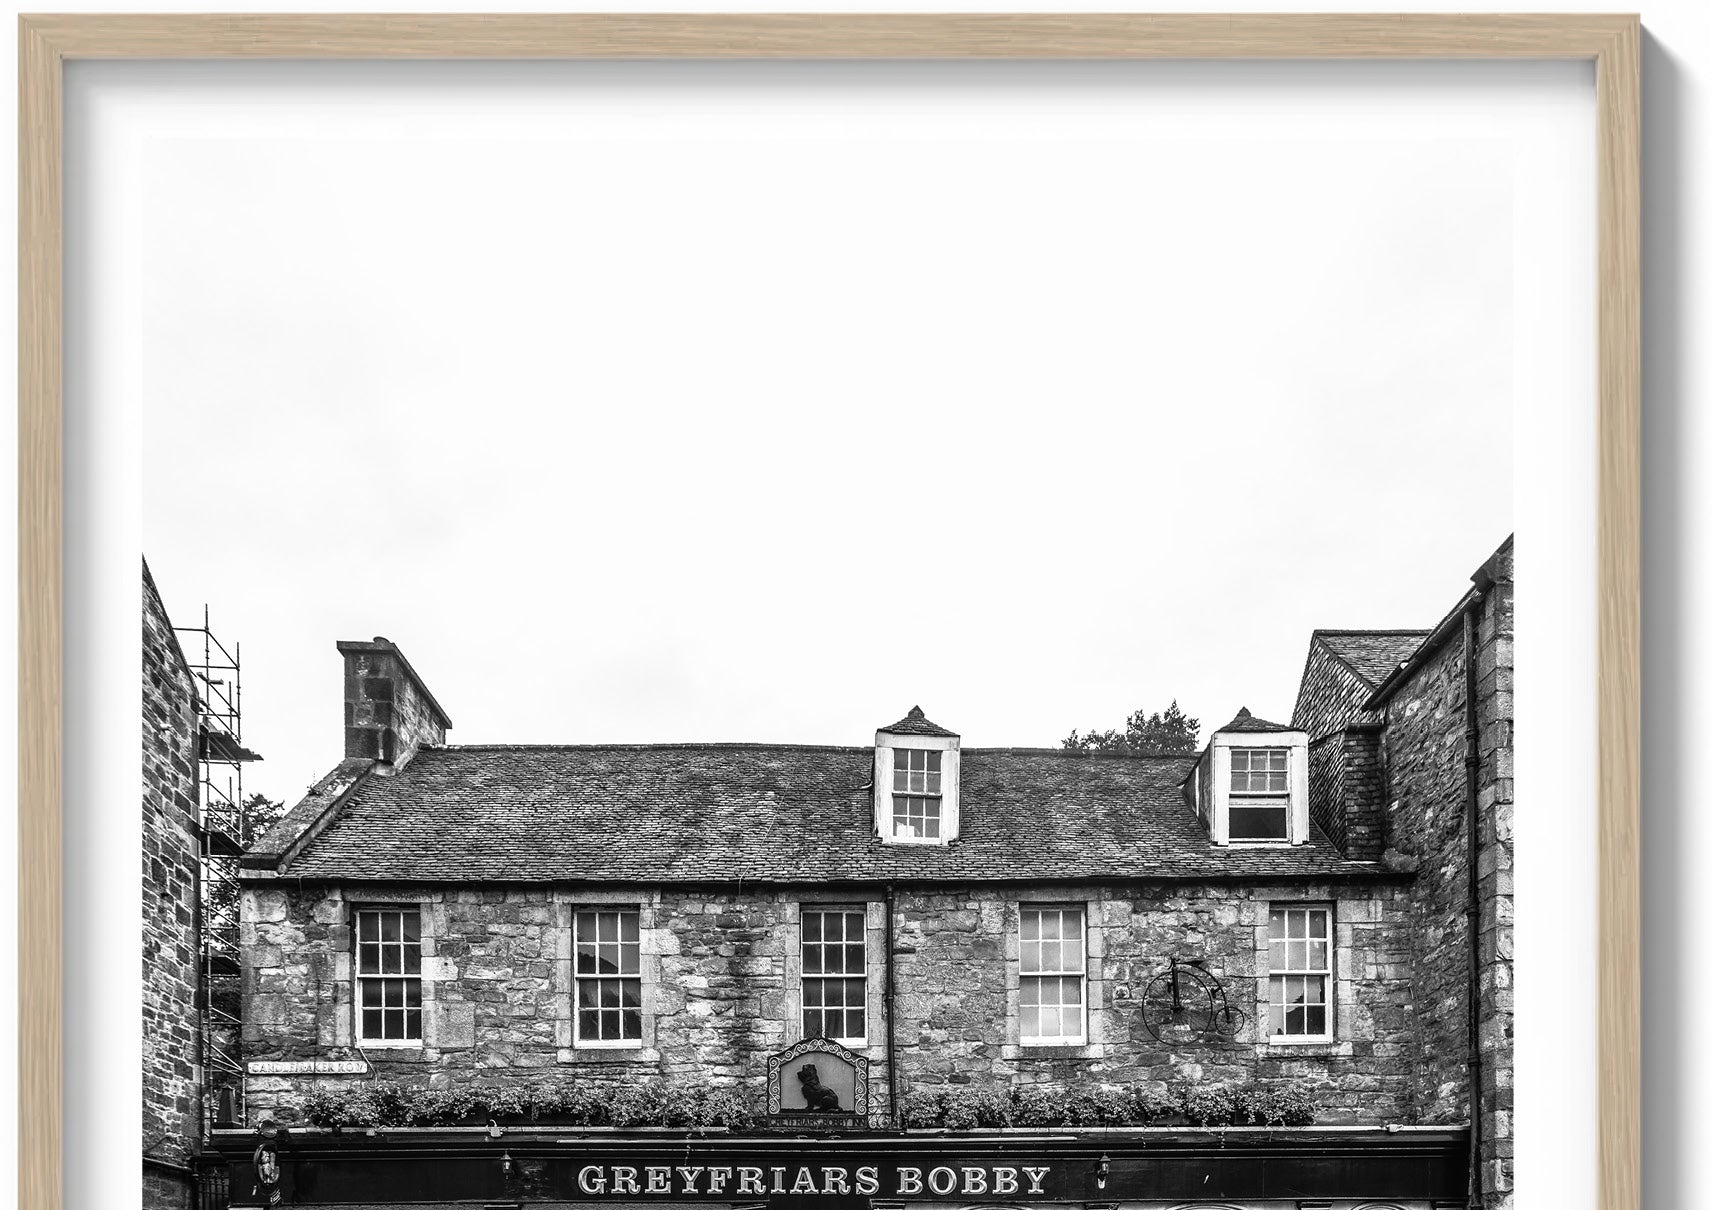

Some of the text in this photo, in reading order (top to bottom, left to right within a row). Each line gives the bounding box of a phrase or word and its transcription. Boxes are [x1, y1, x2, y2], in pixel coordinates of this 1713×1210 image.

[338, 1062, 364, 1073] ROW
[769, 1118, 819, 1127] GREYFRIARS
[823, 1118, 849, 1127] BOBBY
[577, 1165, 1051, 1195] GREYFRIARS BOBBY
